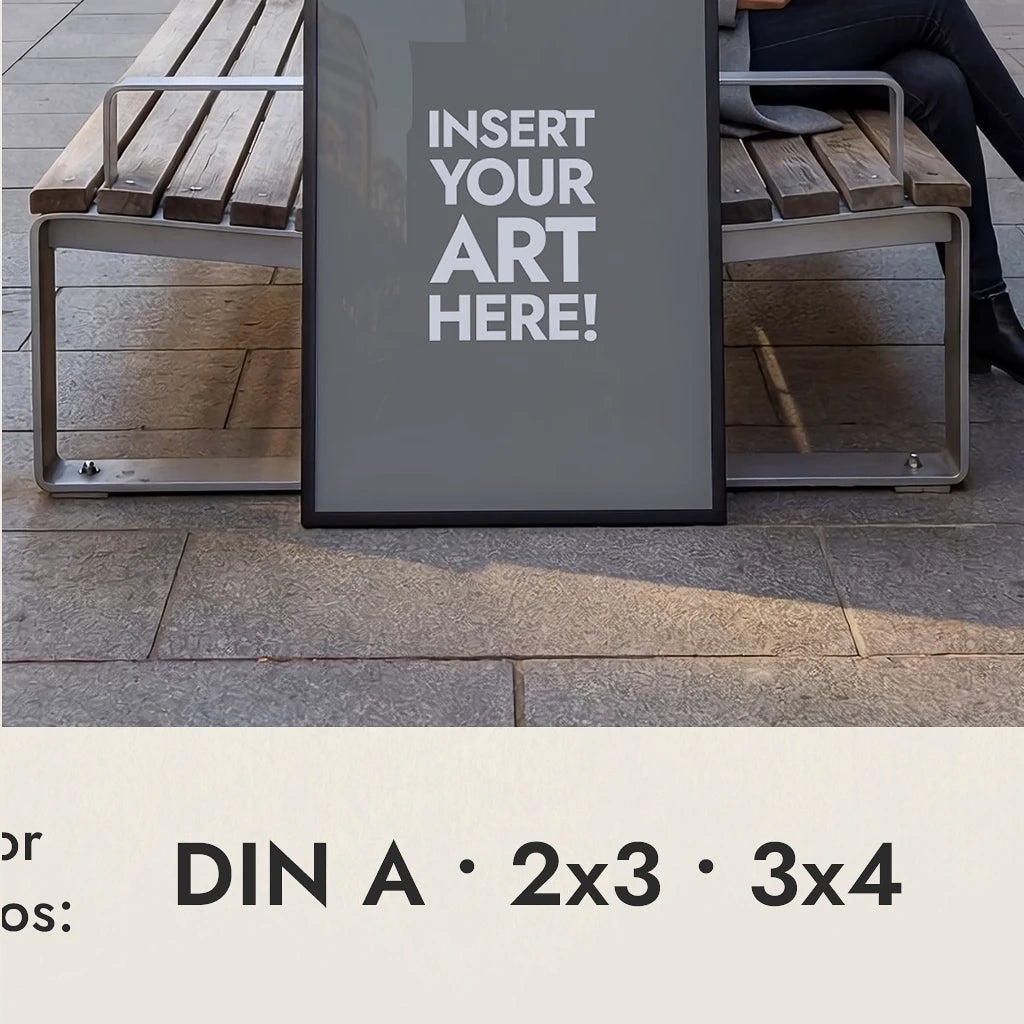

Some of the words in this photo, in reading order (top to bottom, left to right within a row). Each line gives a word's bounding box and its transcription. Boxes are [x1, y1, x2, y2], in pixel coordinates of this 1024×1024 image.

[429, 110, 596, 149] INSERT
[429, 157, 596, 207] YOUR
[429, 214, 597, 283] ART
[429, 294, 598, 342] HERE!
